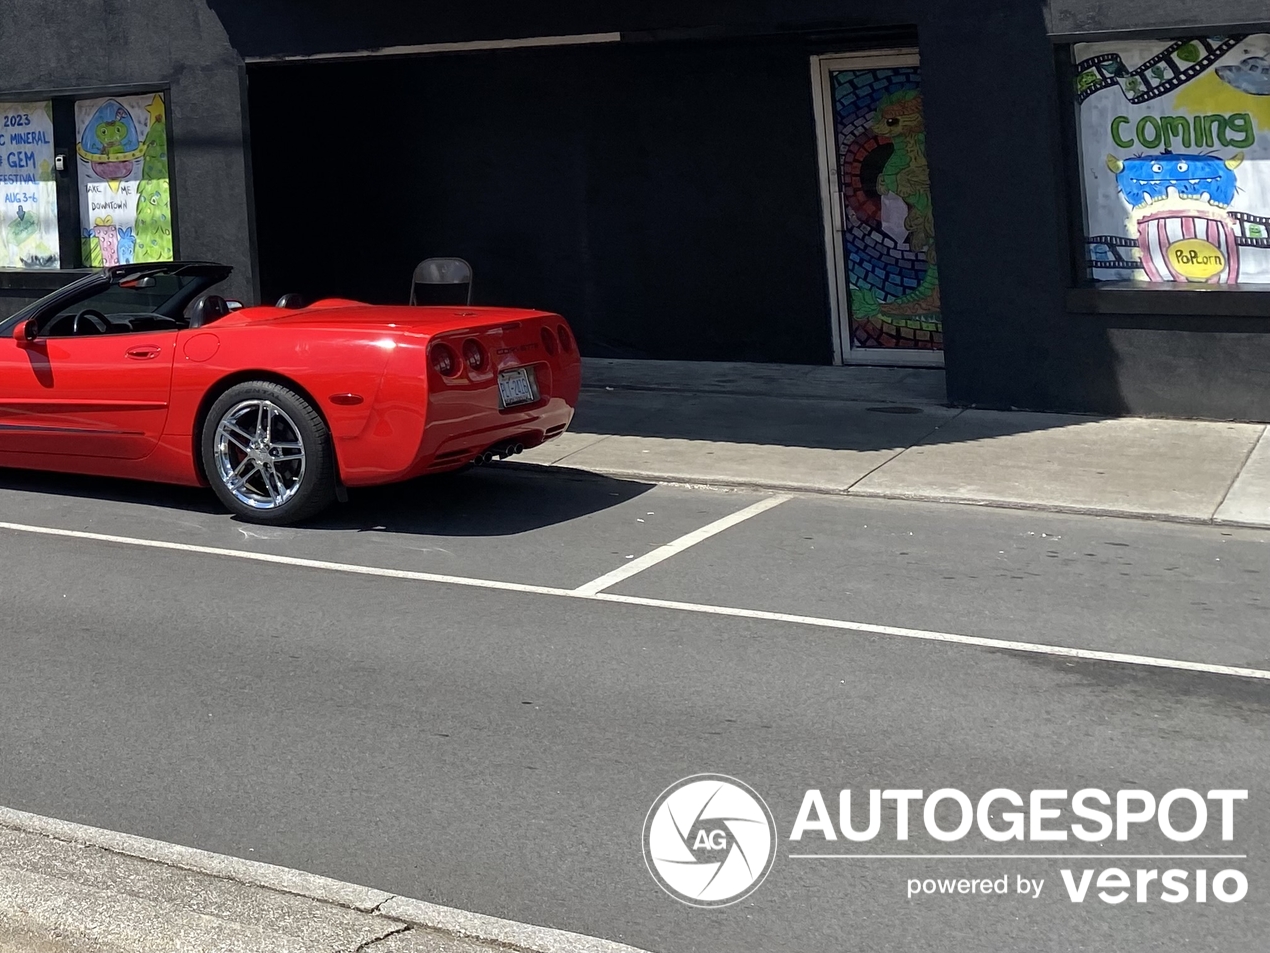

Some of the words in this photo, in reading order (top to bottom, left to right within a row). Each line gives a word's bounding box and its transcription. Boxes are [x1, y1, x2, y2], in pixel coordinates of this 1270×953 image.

[3, 114, 31, 128] 2023
[10, 130, 51, 146] MINERAL
[7, 151, 37, 169] GEM
[85, 183, 103, 194] TAKE
[121, 185, 132, 196] ME
[4, 193, 21, 204] AUG
[22, 192, 38, 203] 3-6
[91, 200, 128, 211] DOWNTOWN
